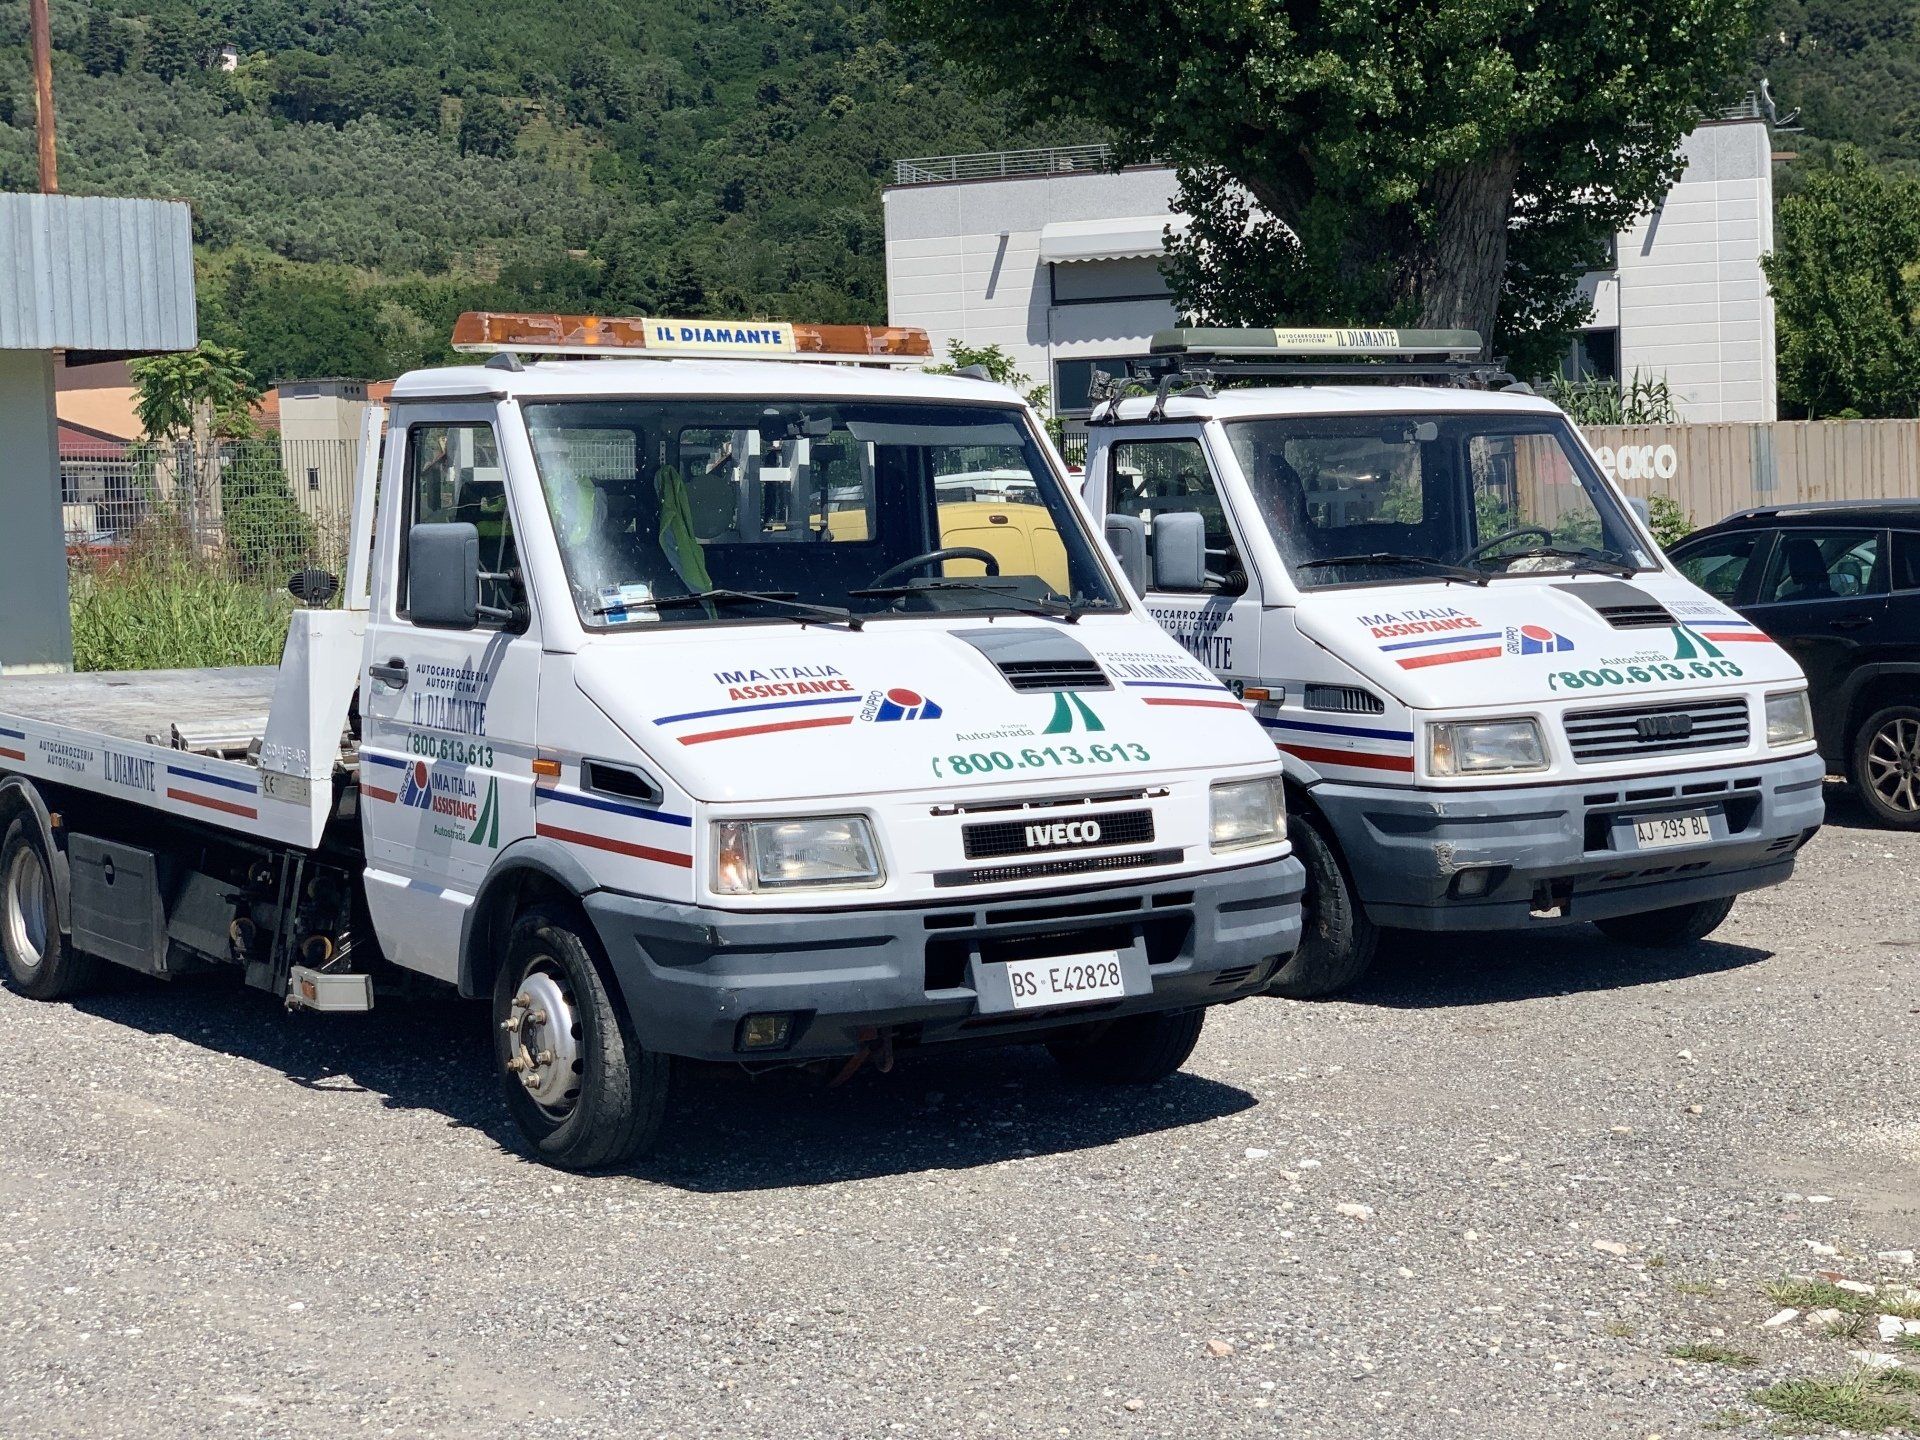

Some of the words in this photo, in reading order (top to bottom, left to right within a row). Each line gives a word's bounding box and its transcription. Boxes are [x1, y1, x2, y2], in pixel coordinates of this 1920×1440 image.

[656, 327, 675, 341] IL
[680, 327, 782, 344] DIAMANTE
[1335, 331, 1346, 347] IL
[1348, 331, 1397, 347] DIAMANTE
[1572, 444, 1677, 486] eaco
[1147, 608, 1233, 622] TOCARROZZERIA
[1157, 619, 1218, 632] UTOFFICINA
[1357, 613, 1400, 626] IMA
[1401, 607, 1466, 621] ITALIA
[1370, 617, 1483, 639] ASSISTANCE
[1506, 626, 1519, 655] GRUPPO
[1600, 653, 1670, 666] Autostrada
[416, 663, 489, 683] AUTOCARROZZERIA
[713, 669, 769, 684] IMA
[770, 665, 843, 680] ITALIA
[1558, 660, 1743, 689] 800.613.613
[426, 677, 476, 694] AUTOFFICINA
[728, 679, 855, 701] ASSISTANCE
[412, 692, 423, 726] IL
[426, 694, 487, 737] DIAMANTE
[859, 690, 883, 722] GRUPPO
[955, 728, 1035, 742] Autostrada
[39, 740, 94, 762] AUTOCARROZZERIA
[413, 733, 494, 768] 800.613.613
[948, 743, 1151, 775] 800.613.613
[47, 754, 86, 772] AUTOFFICINA
[104, 750, 112, 782] IL
[114, 752, 156, 792] DIAMANTE
[399, 760, 415, 802] GRUPPO
[432, 772, 450, 791] IMA
[451, 773, 477, 798] ITALIA
[432, 795, 477, 822] ASSISTANCE
[433, 824, 466, 842] Autostrada
[1025, 820, 1101, 847] IVECO
[1637, 822, 1655, 842] AJ
[1662, 818, 1687, 839] 293
[1692, 816, 1709, 835] BL
[1011, 971, 1037, 997] BS
[1049, 962, 1120, 993] E42828
